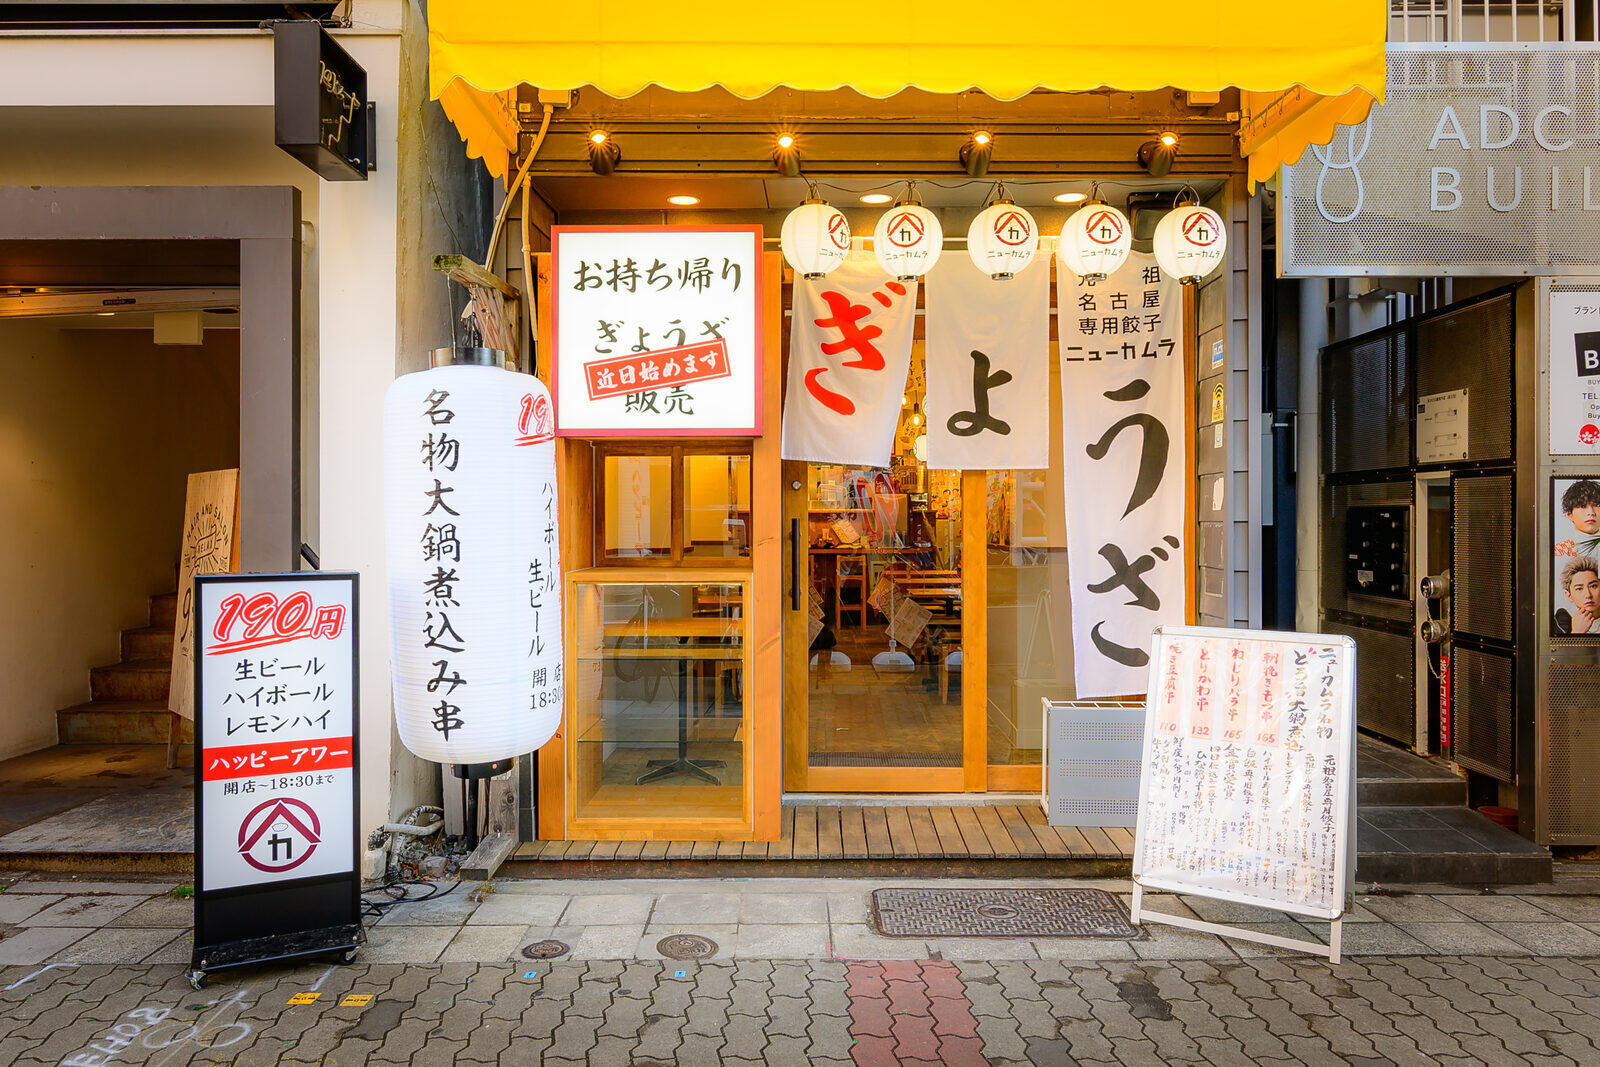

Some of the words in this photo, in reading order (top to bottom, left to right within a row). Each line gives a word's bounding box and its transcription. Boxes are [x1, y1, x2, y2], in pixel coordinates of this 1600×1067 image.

[1428, 105, 1574, 152] ADC
[1430, 166, 1600, 213] BUIL
[899, 227, 912, 242] カ
[1008, 226, 1020, 240] カ
[1100, 225, 1113, 239] カ
[1196, 226, 1209, 241] カ
[884, 250, 928, 261] ニューカムラ
[987, 250, 1031, 259] ニューカムラ
[1081, 247, 1124, 258] ニューカムラ
[1176, 249, 1221, 260] ニューカムラ
[573, 257, 742, 295] お持ち帰り
[1078, 290, 1161, 312] 名古屋
[1574, 305, 1600, 316] ブラン
[594, 316, 730, 354] ぎょうざ
[1078, 314, 1162, 336] 専用餃子
[1066, 338, 1176, 362] ニューカムラ
[596, 350, 719, 390] 近日始めます
[625, 385, 695, 415] 販売
[201, 503, 213, 515] AND
[542, 482, 557, 592] ハイボール
[420, 388, 468, 742] 名物大鍋煮込み串
[213, 590, 347, 642] 190円
[528, 558, 546, 658] 生ビール
[234, 656, 326, 682] 生ビール
[1196, 648, 1212, 711] とりかわ串
[222, 683, 335, 708] ハイボール
[1316, 647, 1338, 740] ニューカムラ名物
[226, 709, 332, 737] レモンハイ
[1160, 722, 1176, 731] 110
[1191, 726, 1209, 735] 132
[1224, 729, 1242, 739] 165
[1257, 733, 1275, 743] 165
[209, 744, 349, 772] ハッピーアワー
[267, 832, 293, 862] カ
